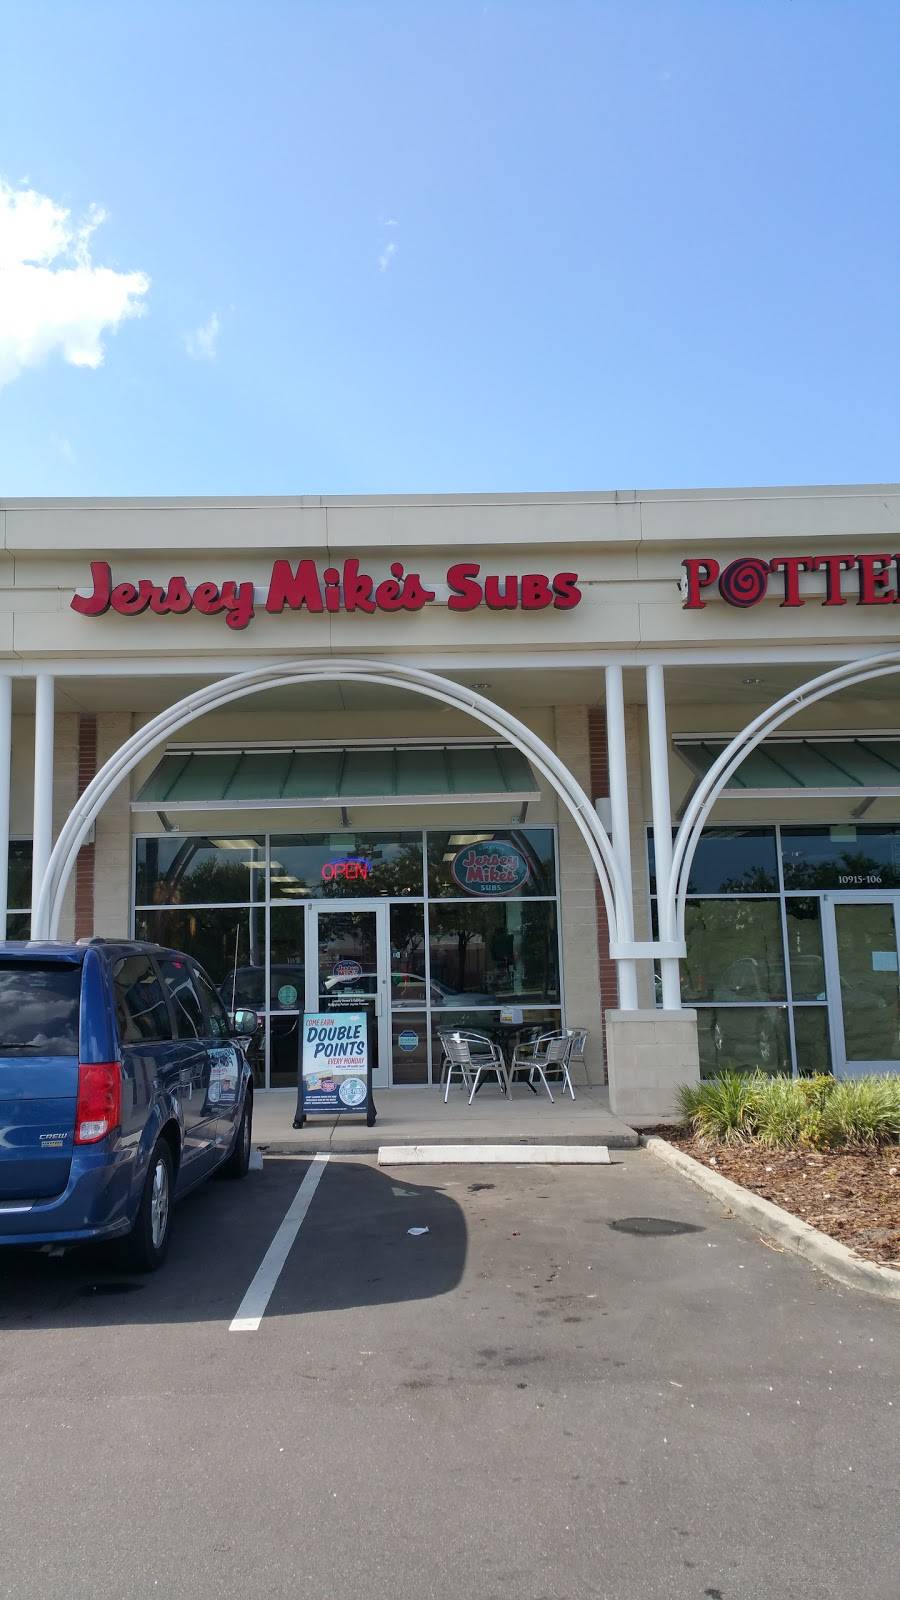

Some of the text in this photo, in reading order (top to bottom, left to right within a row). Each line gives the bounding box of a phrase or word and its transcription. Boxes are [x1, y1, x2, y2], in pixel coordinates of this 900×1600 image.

[681, 554, 900, 610] POTTE
[70, 561, 255, 630] Jersey
[265, 558, 436, 614] Mike's
[463, 850, 519, 871] Jersey
[321, 863, 368, 881] OPEN
[838, 875, 882, 884] 10915-106
[307, 1025, 362, 1043] DOUBLE
[314, 1041, 365, 1059] POINTS
[343, 1057, 365, 1065] MONDAY
